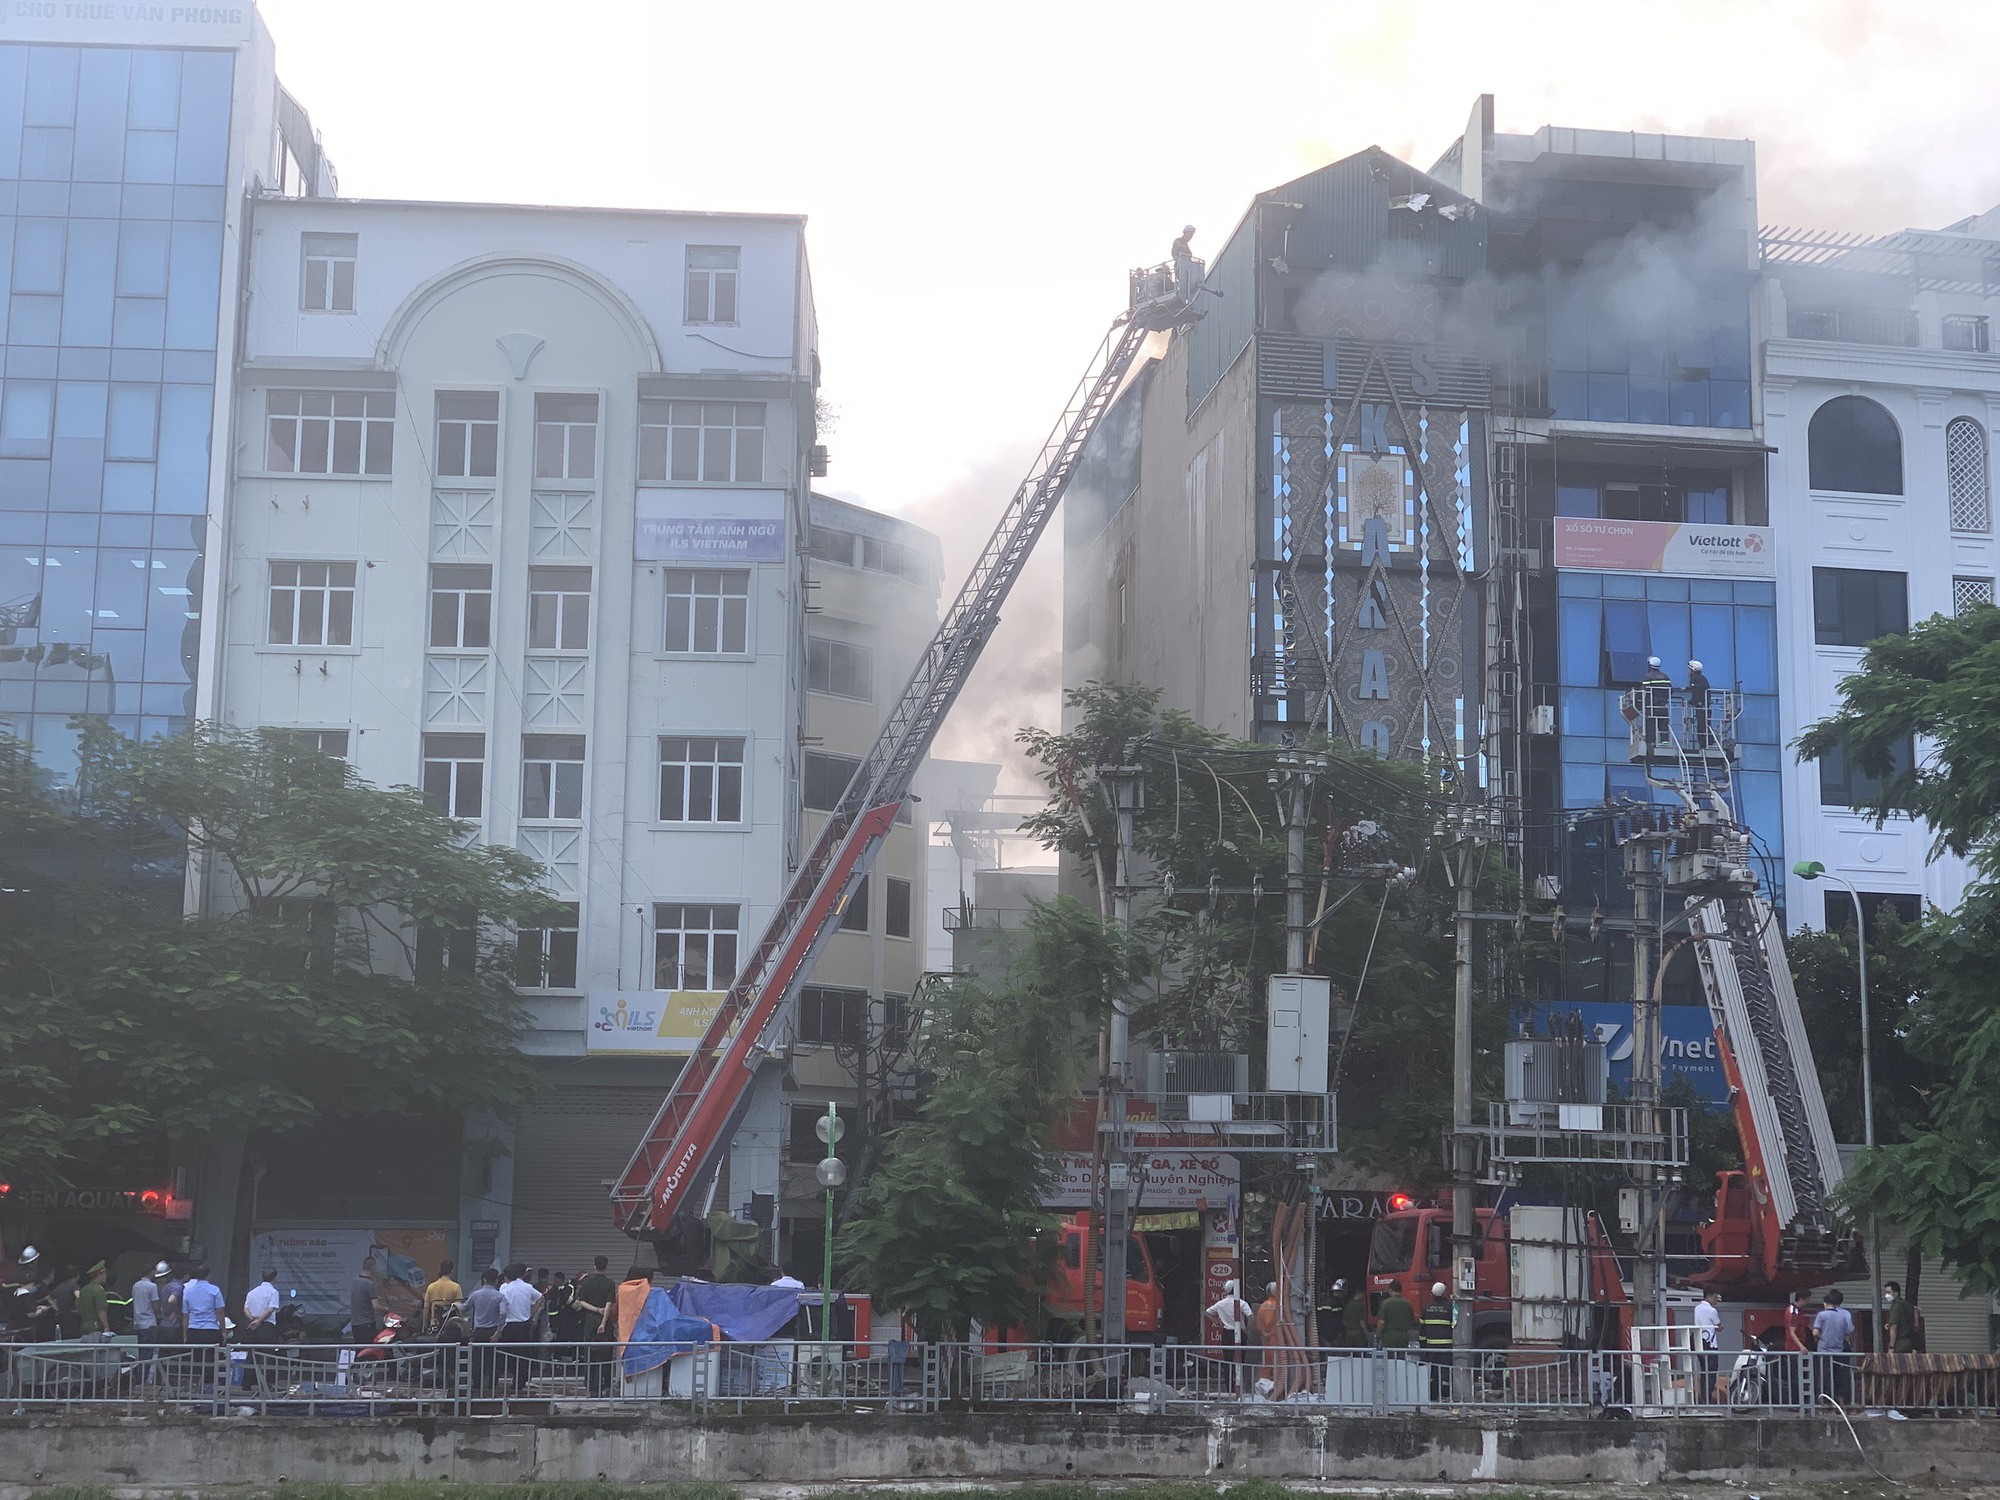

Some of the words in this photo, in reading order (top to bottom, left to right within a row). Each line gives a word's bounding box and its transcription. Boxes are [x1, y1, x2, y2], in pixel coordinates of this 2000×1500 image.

[14, 2, 57, 18] CHO
[63, 1, 115, 20] THUÊ
[122, 3, 164, 22] VĂN
[170, 5, 242, 24] PHÒNG
[642, 524, 685, 535] TRUNG
[687, 523, 716, 535] TÂM
[717, 526, 746, 536] ANH
[748, 525, 777, 536] NGỮ
[1608, 526, 1635, 537] CHỌN
[669, 539, 690, 549] ILS
[692, 540, 749, 550] VIETNAM
[1689, 535, 1742, 548] Vietlott
[679, 1007, 700, 1016] ANH
[627, 1010, 656, 1026] ILS
[693, 1019, 709, 1028] ILS
[1672, 1063, 1715, 1073] Payment
[1151, 1159, 1176, 1171] GA,
[1179, 1159, 1197, 1170] XE
[661, 1142, 698, 1205] MORITA
[1213, 1267, 1230, 1275] 229
[1210, 1290, 1221, 1301] Xe
